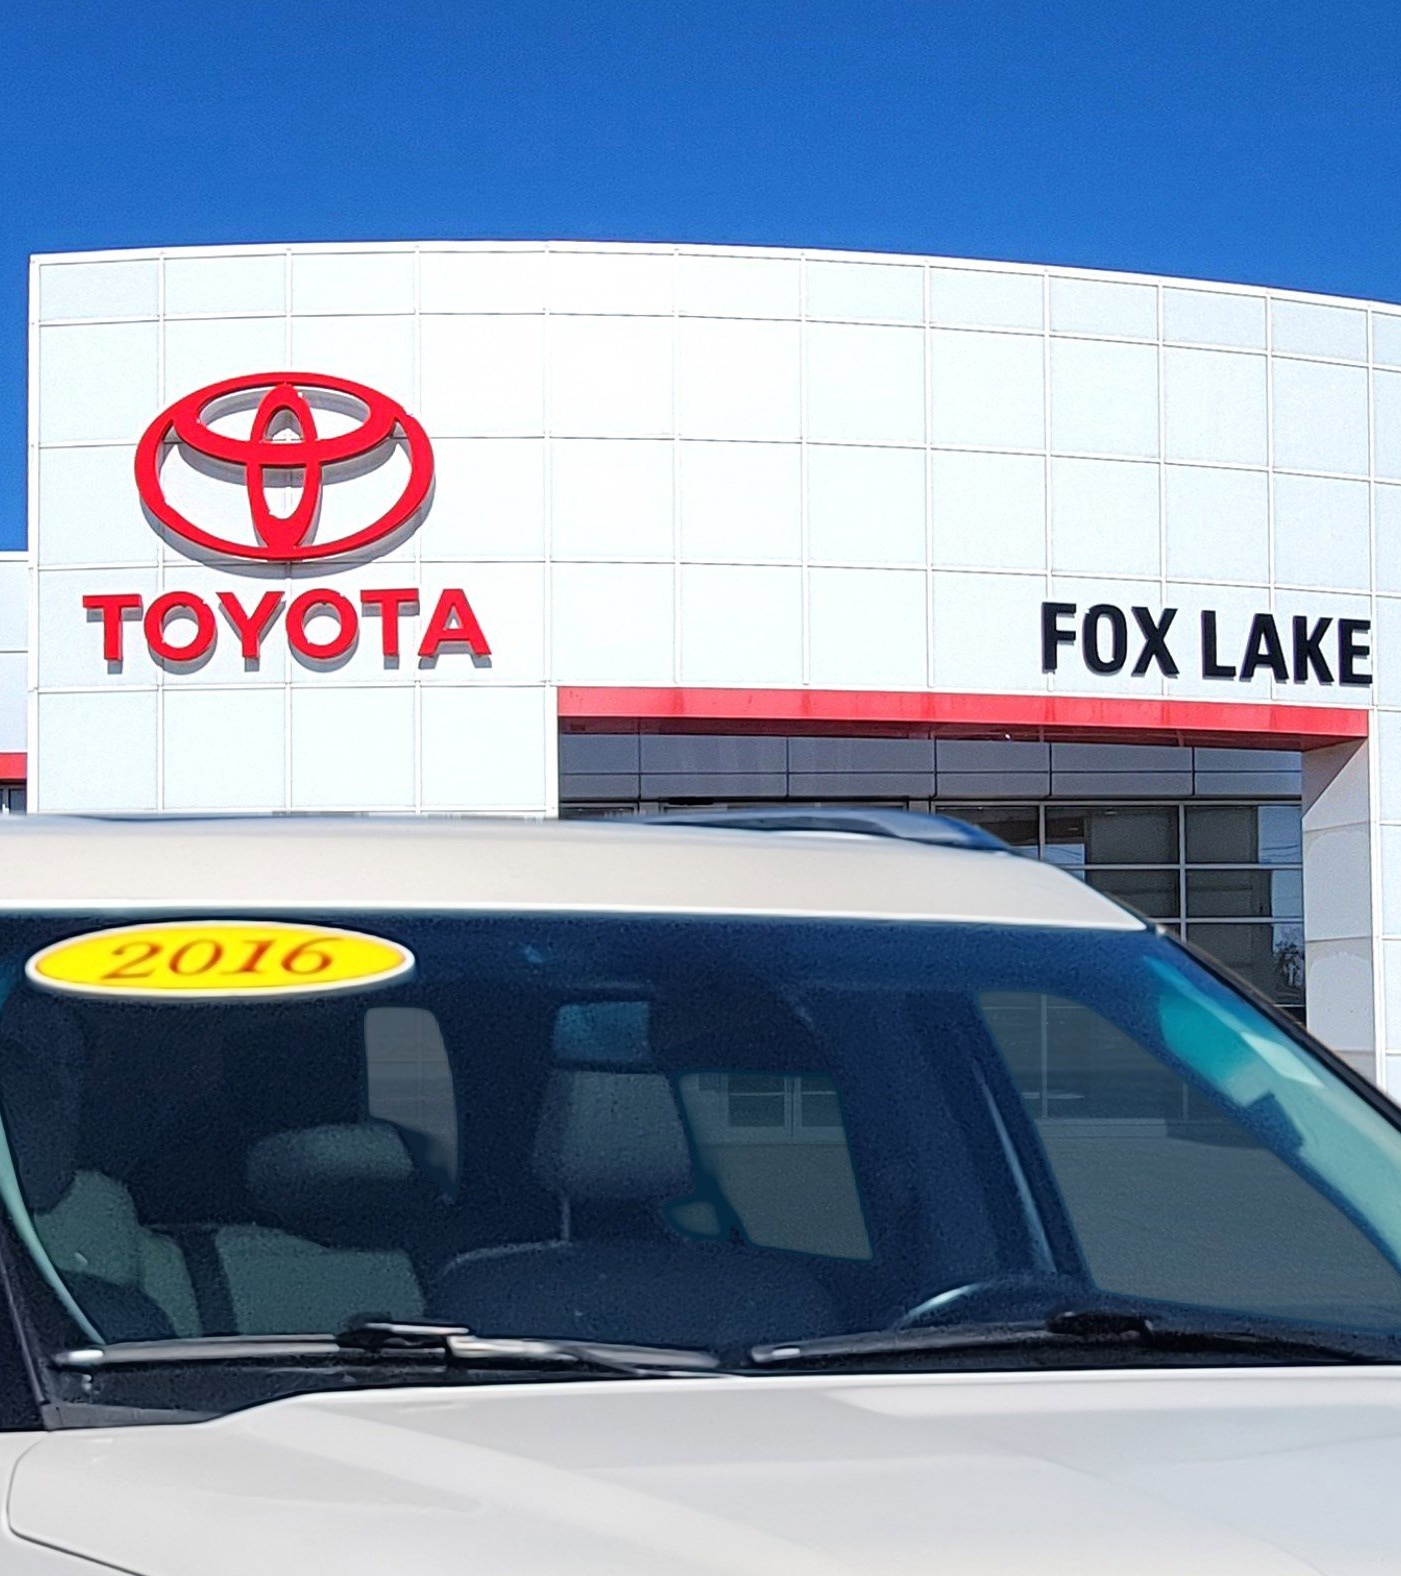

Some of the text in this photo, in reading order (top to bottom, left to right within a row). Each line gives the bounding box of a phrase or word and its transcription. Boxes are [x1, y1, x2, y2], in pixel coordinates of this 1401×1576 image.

[82, 587, 492, 664] TOYOTA
[1042, 601, 1374, 686] FOX LAKE
[100, 936, 344, 980] 2016
